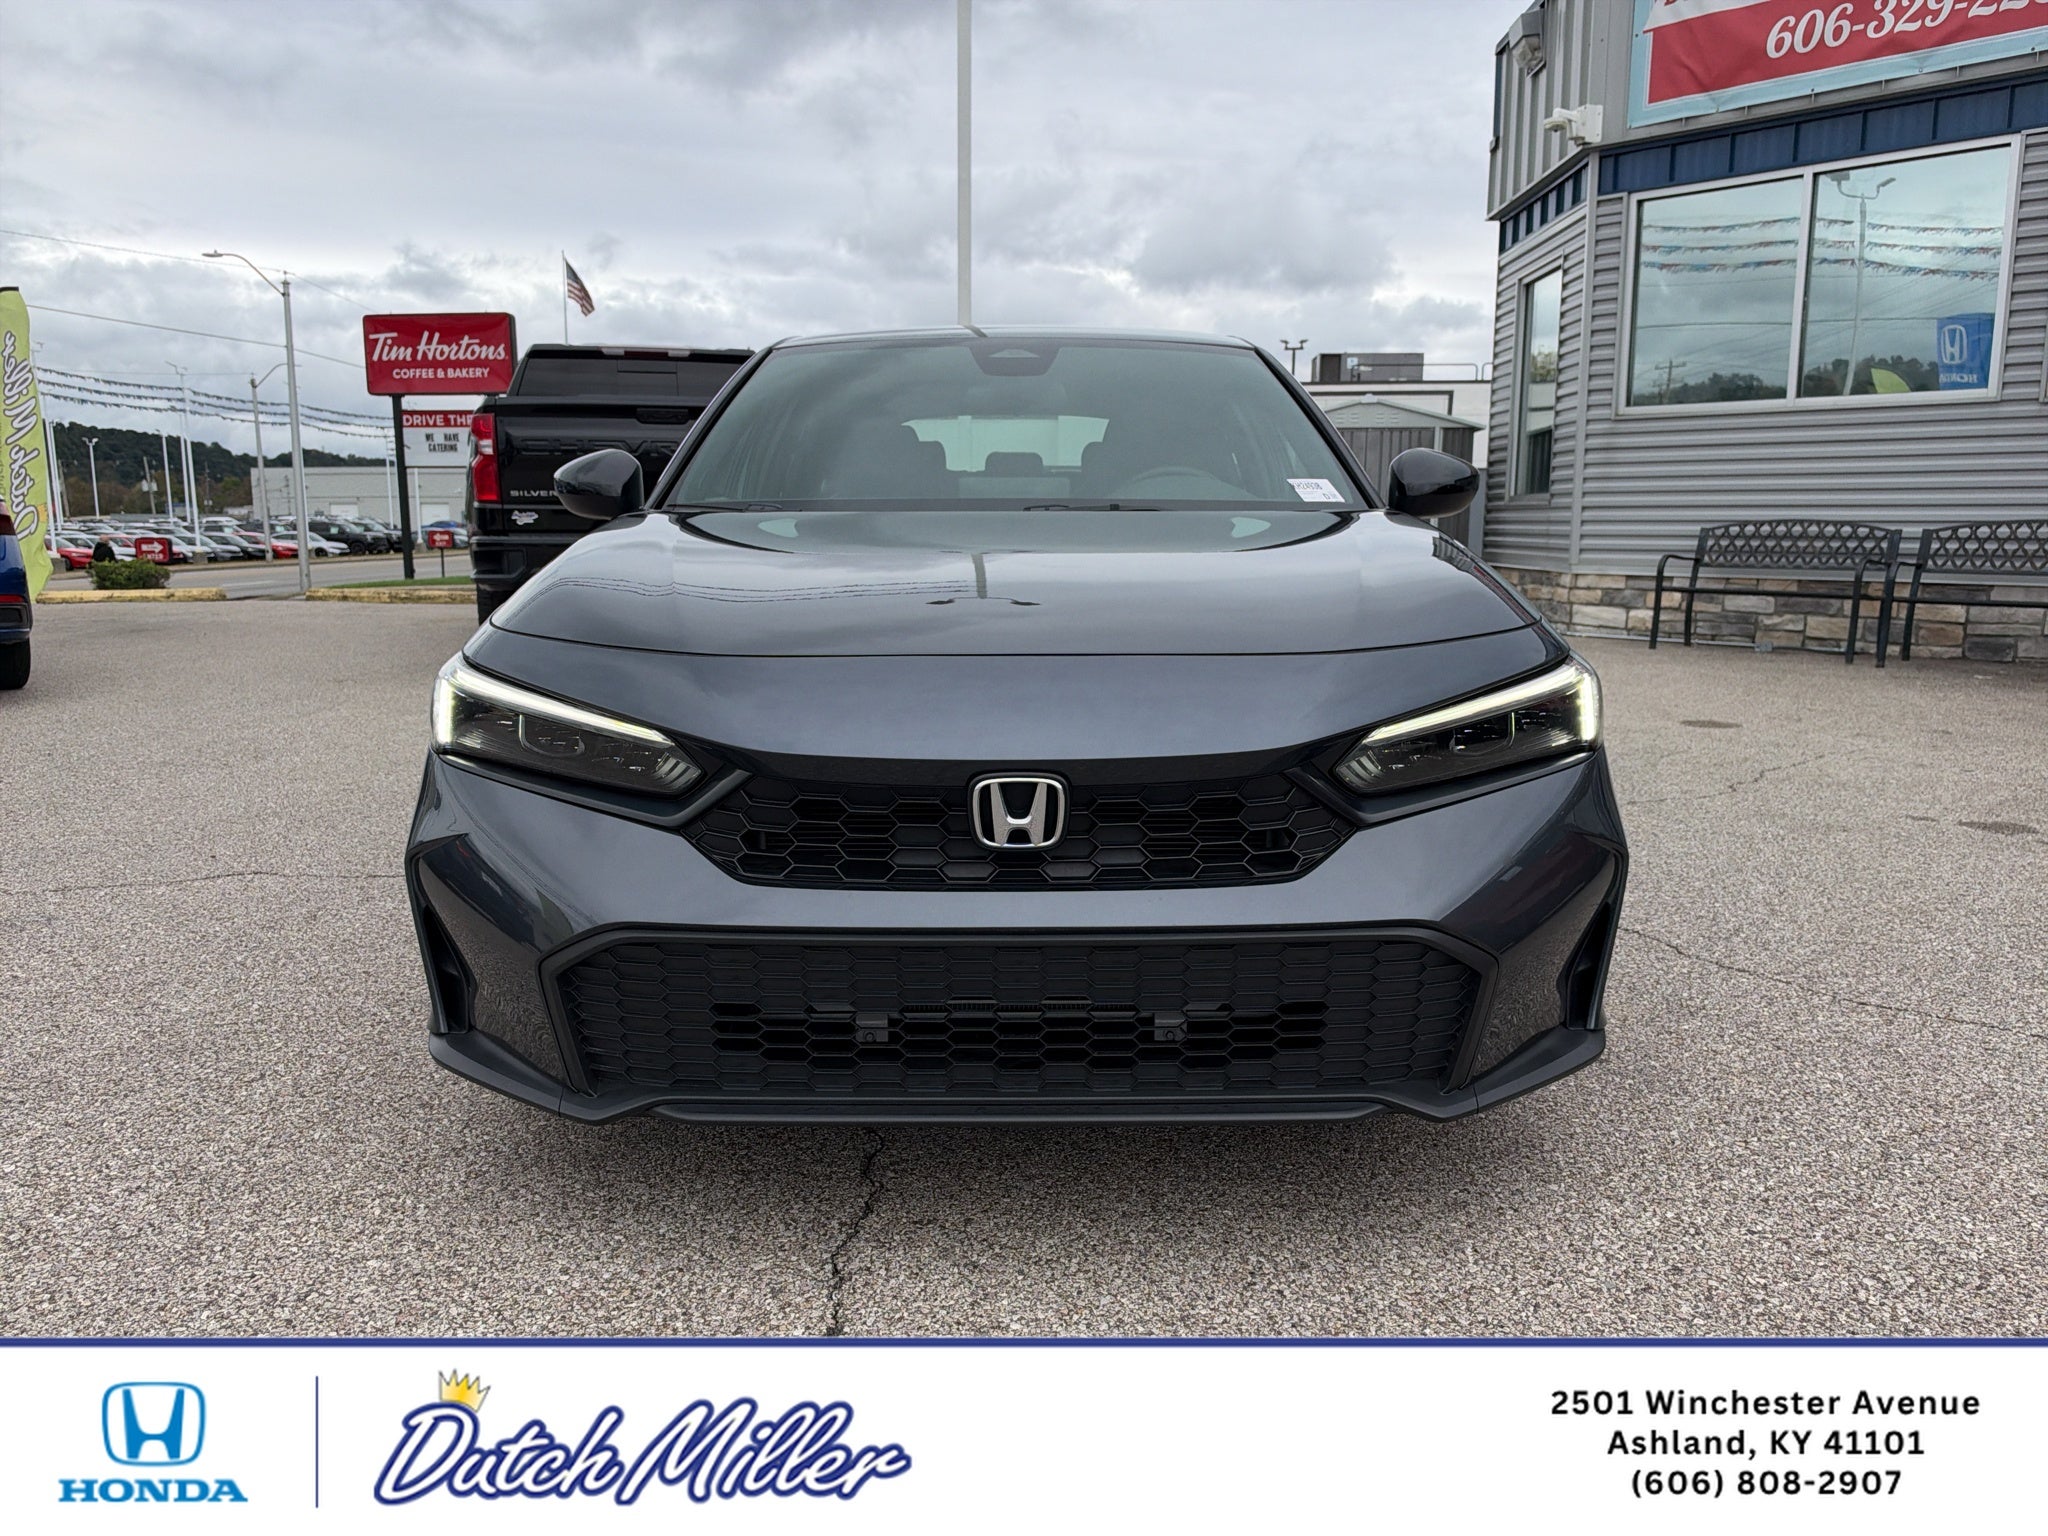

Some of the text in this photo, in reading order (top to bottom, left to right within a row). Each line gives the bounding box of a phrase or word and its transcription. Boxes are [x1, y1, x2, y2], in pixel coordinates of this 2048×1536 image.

[369, 330, 506, 361] Tim Hortons
[392, 366, 490, 379] COFFEE & BAKERY
[402, 414, 445, 426] DRIVE
[425, 432, 460, 442] WE HAVE
[428, 443, 458, 452] CATERING
